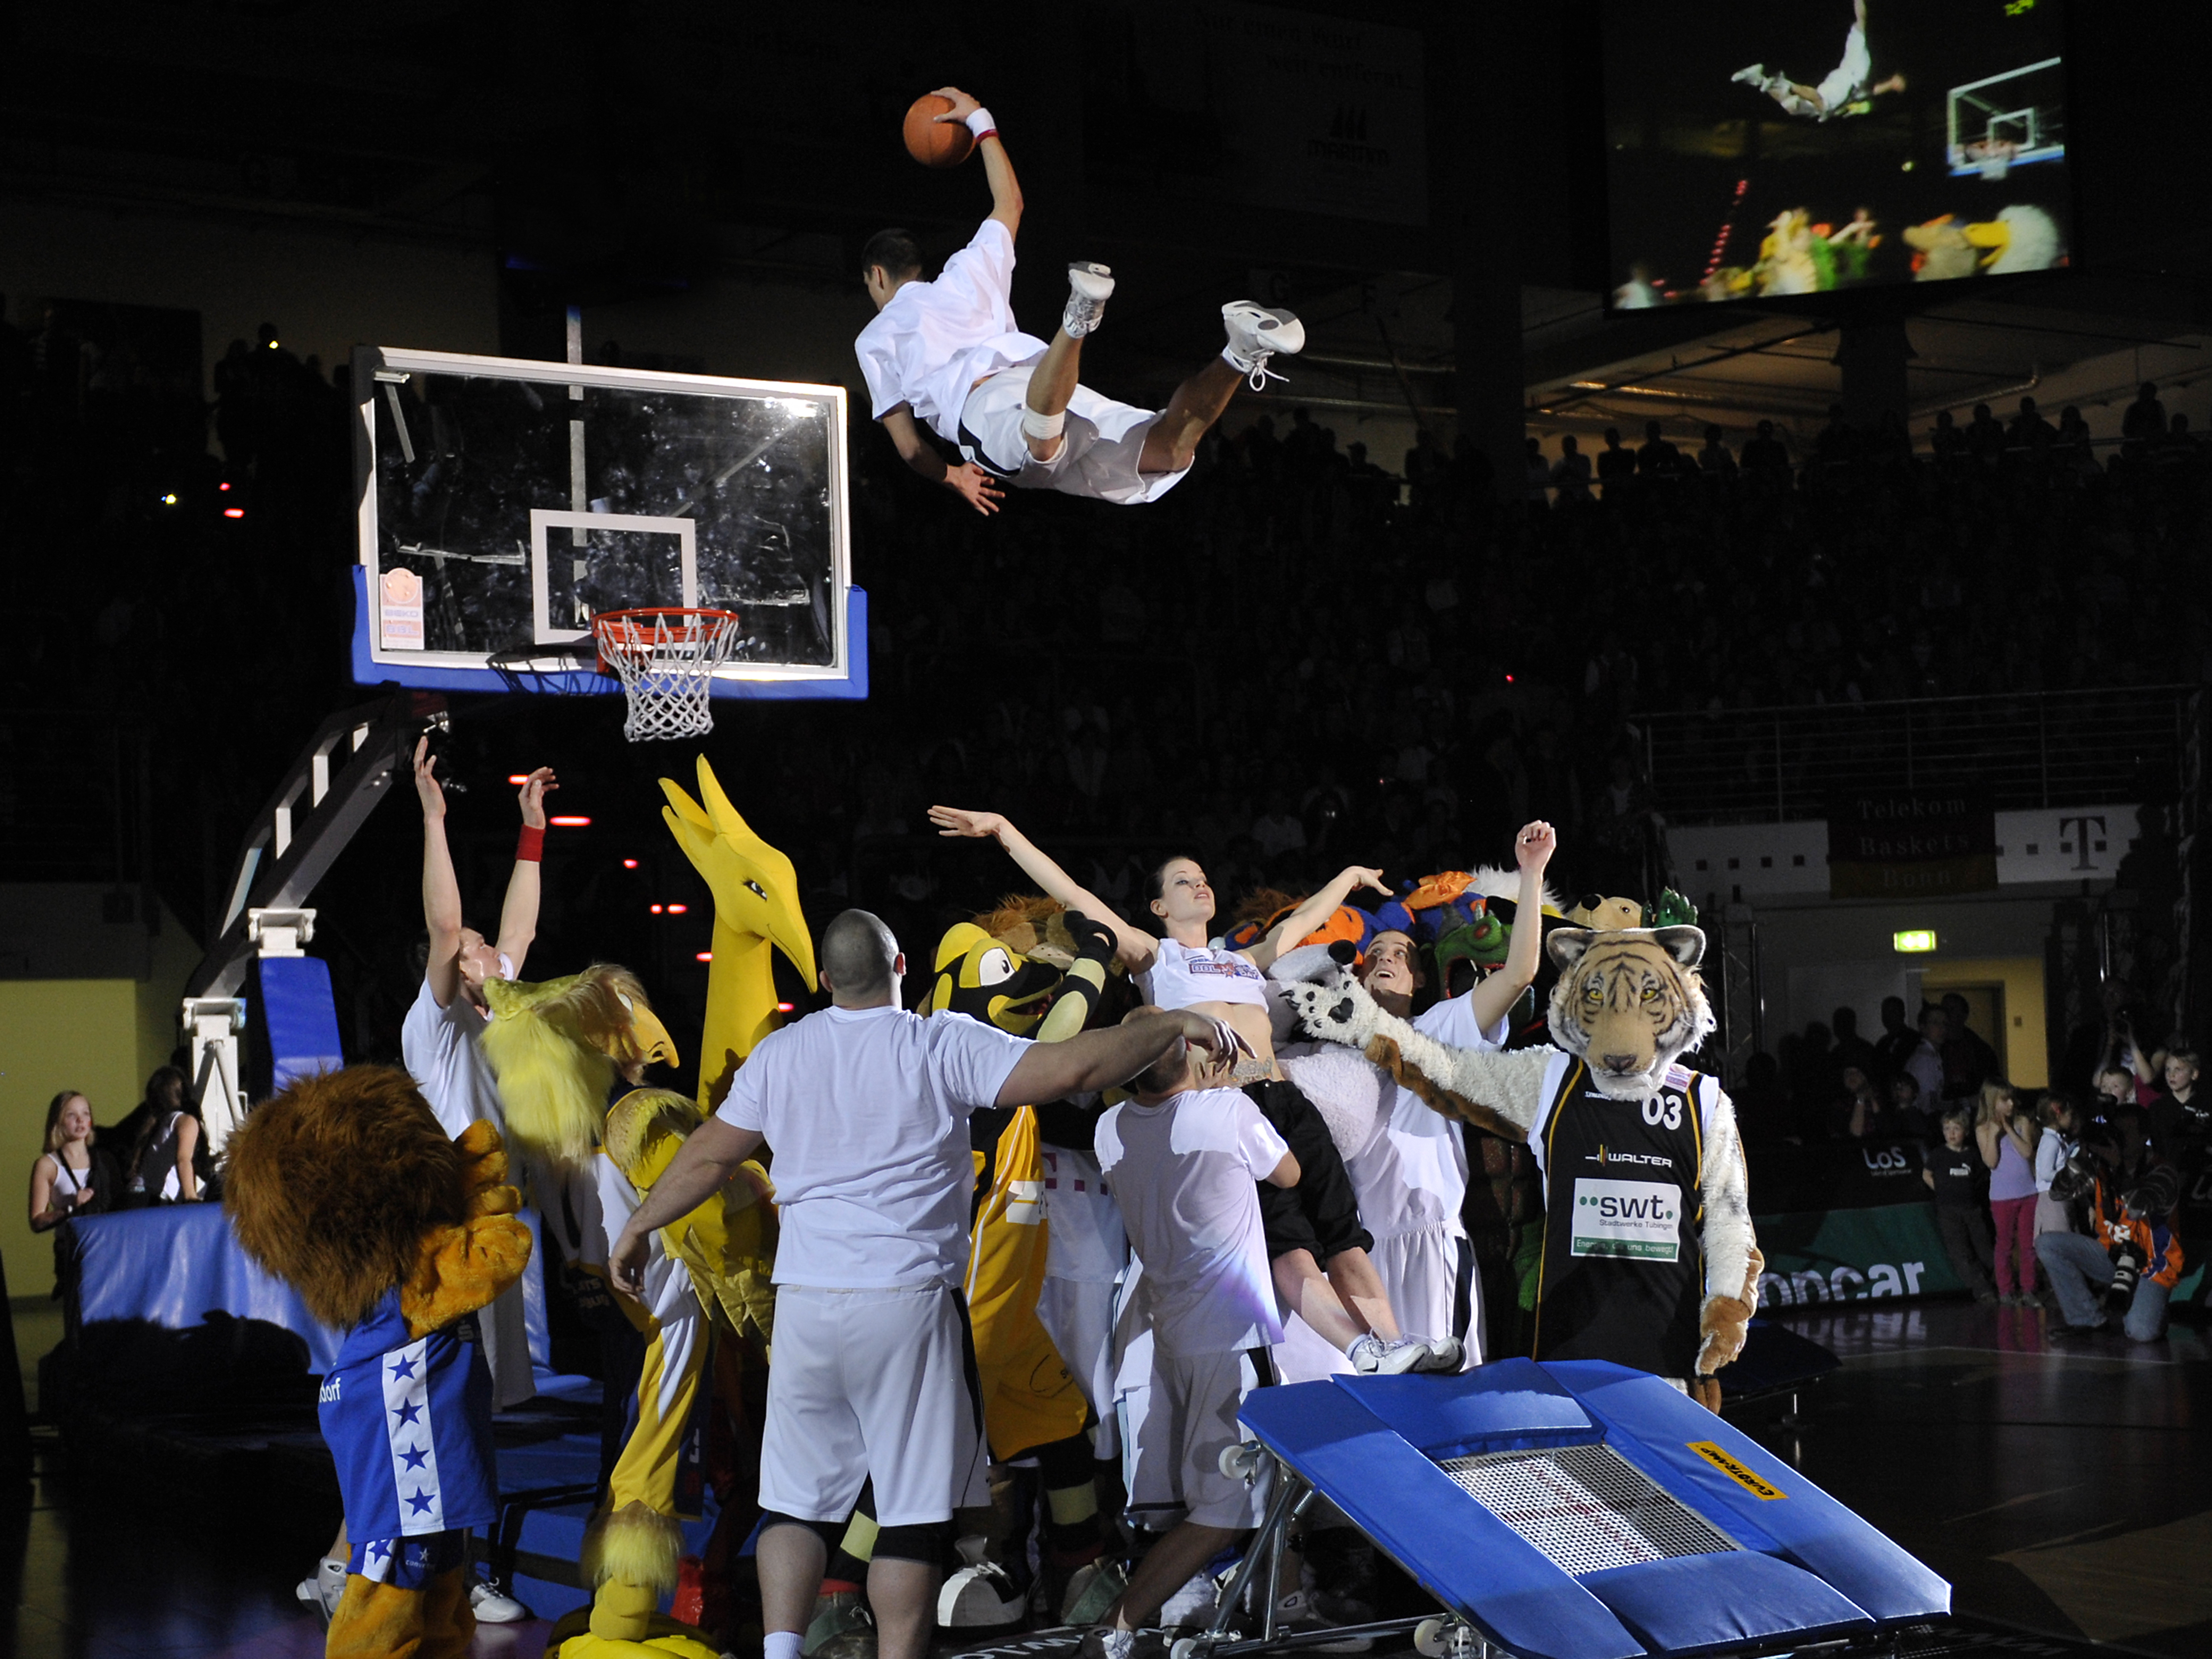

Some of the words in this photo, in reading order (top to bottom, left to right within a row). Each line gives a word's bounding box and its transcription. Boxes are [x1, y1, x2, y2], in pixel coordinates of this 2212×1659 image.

[1857, 798, 1966, 819] Telekom
[1860, 834, 1969, 856] Baskets
[1642, 1091, 1682, 1130] 03
[1608, 1153, 1672, 1168] WALTER
[1599, 1219, 1643, 1228] Stadtwerke
